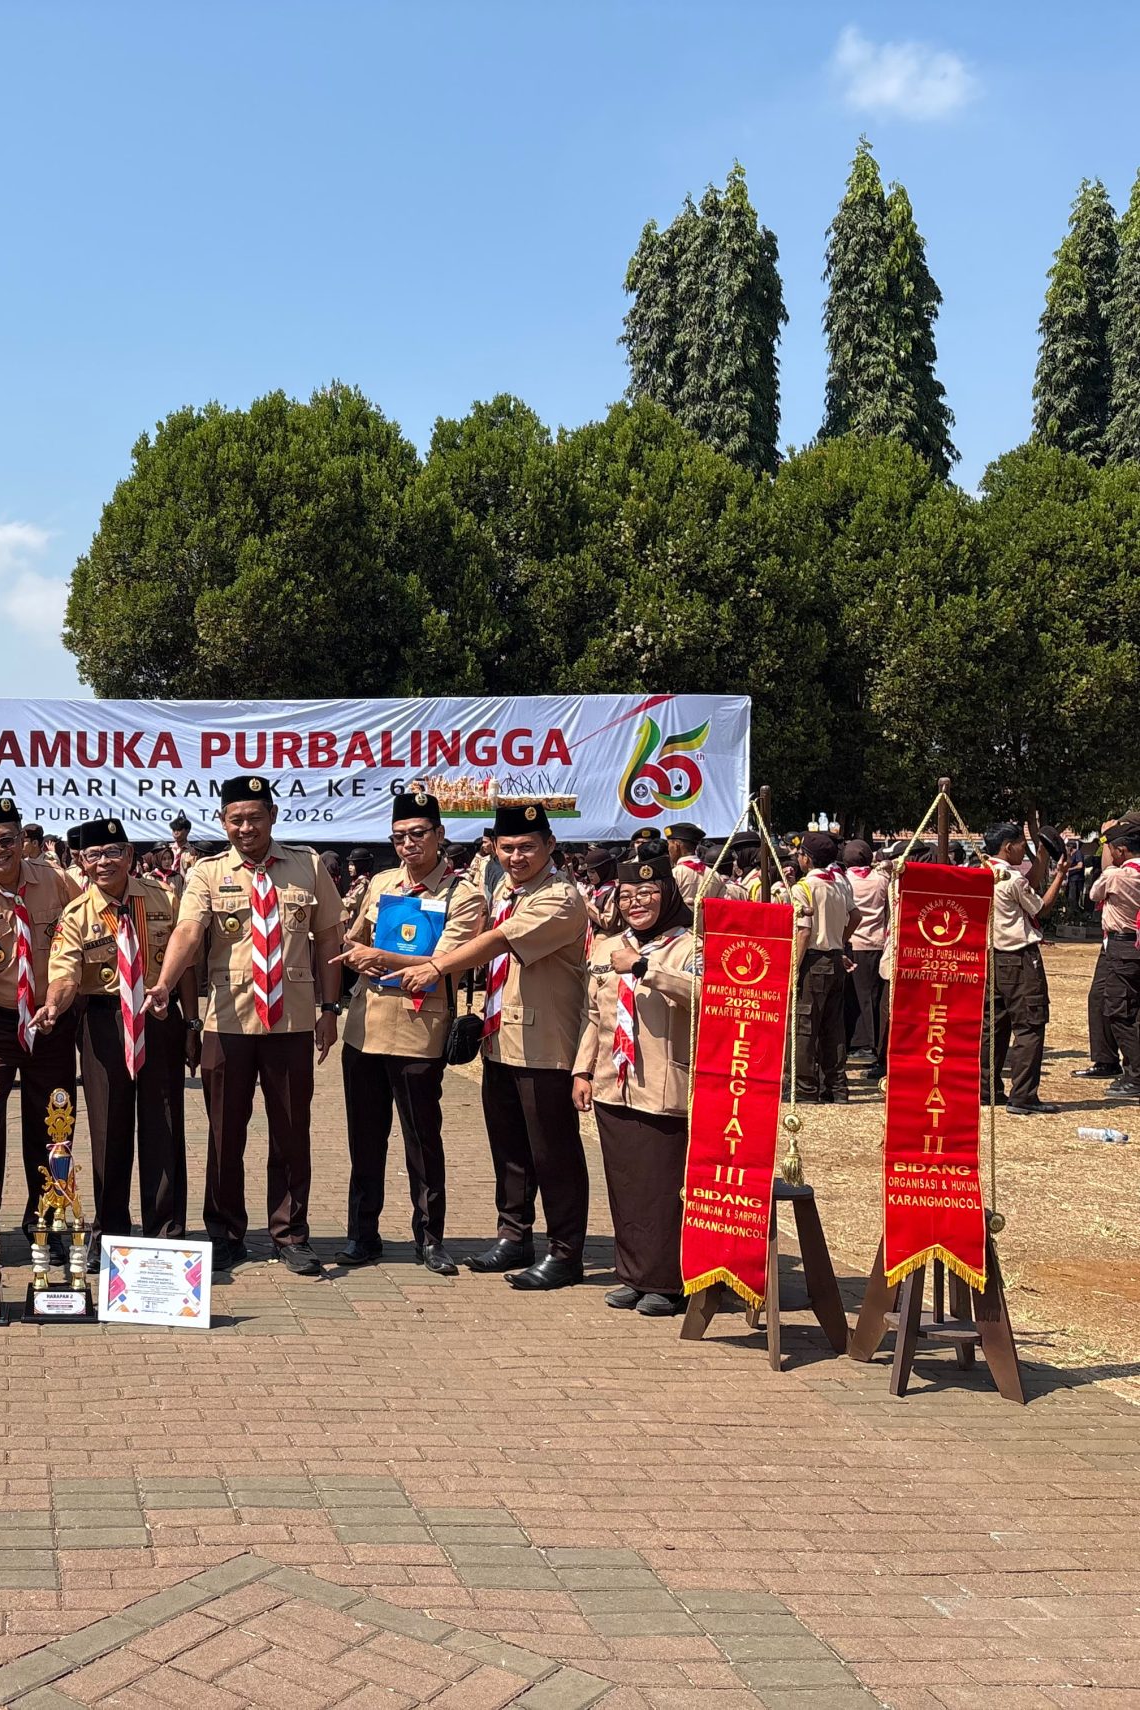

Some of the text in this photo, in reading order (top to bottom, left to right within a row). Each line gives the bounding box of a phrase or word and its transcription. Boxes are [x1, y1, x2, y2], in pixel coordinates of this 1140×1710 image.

[200, 728, 573, 769] PURBALINGGA
[37, 777, 117, 797] HARI
[138, 778, 307, 798] PRAMKA
[282, 808, 334, 822] 2026
[918, 898, 944, 922] GERAKAN
[902, 946, 980, 962] KWARCAB PURBALINGGA
[921, 959, 959, 972] 2026
[900, 968, 979, 984] KWARTIR RANTING
[706, 985, 781, 1001] KWARCAB PURBALINGGA
[724, 997, 761, 1010] 2026
[704, 1005, 780, 1023] KWARTIR RANTING
[921, 983, 949, 1155] TERGIAT II
[713, 1019, 751, 1187] TERGIAT III
[893, 1161, 971, 1176] BIDANG
[888, 1176, 979, 1193] ORGANISASI & HUKUM
[692, 1187, 763, 1209] BIDANG
[888, 1193, 981, 1210] KARANGMONCOL
[687, 1200, 767, 1225] KEUANGAN & SARPRAS
[685, 1216, 766, 1240] KARANGMONCOL
